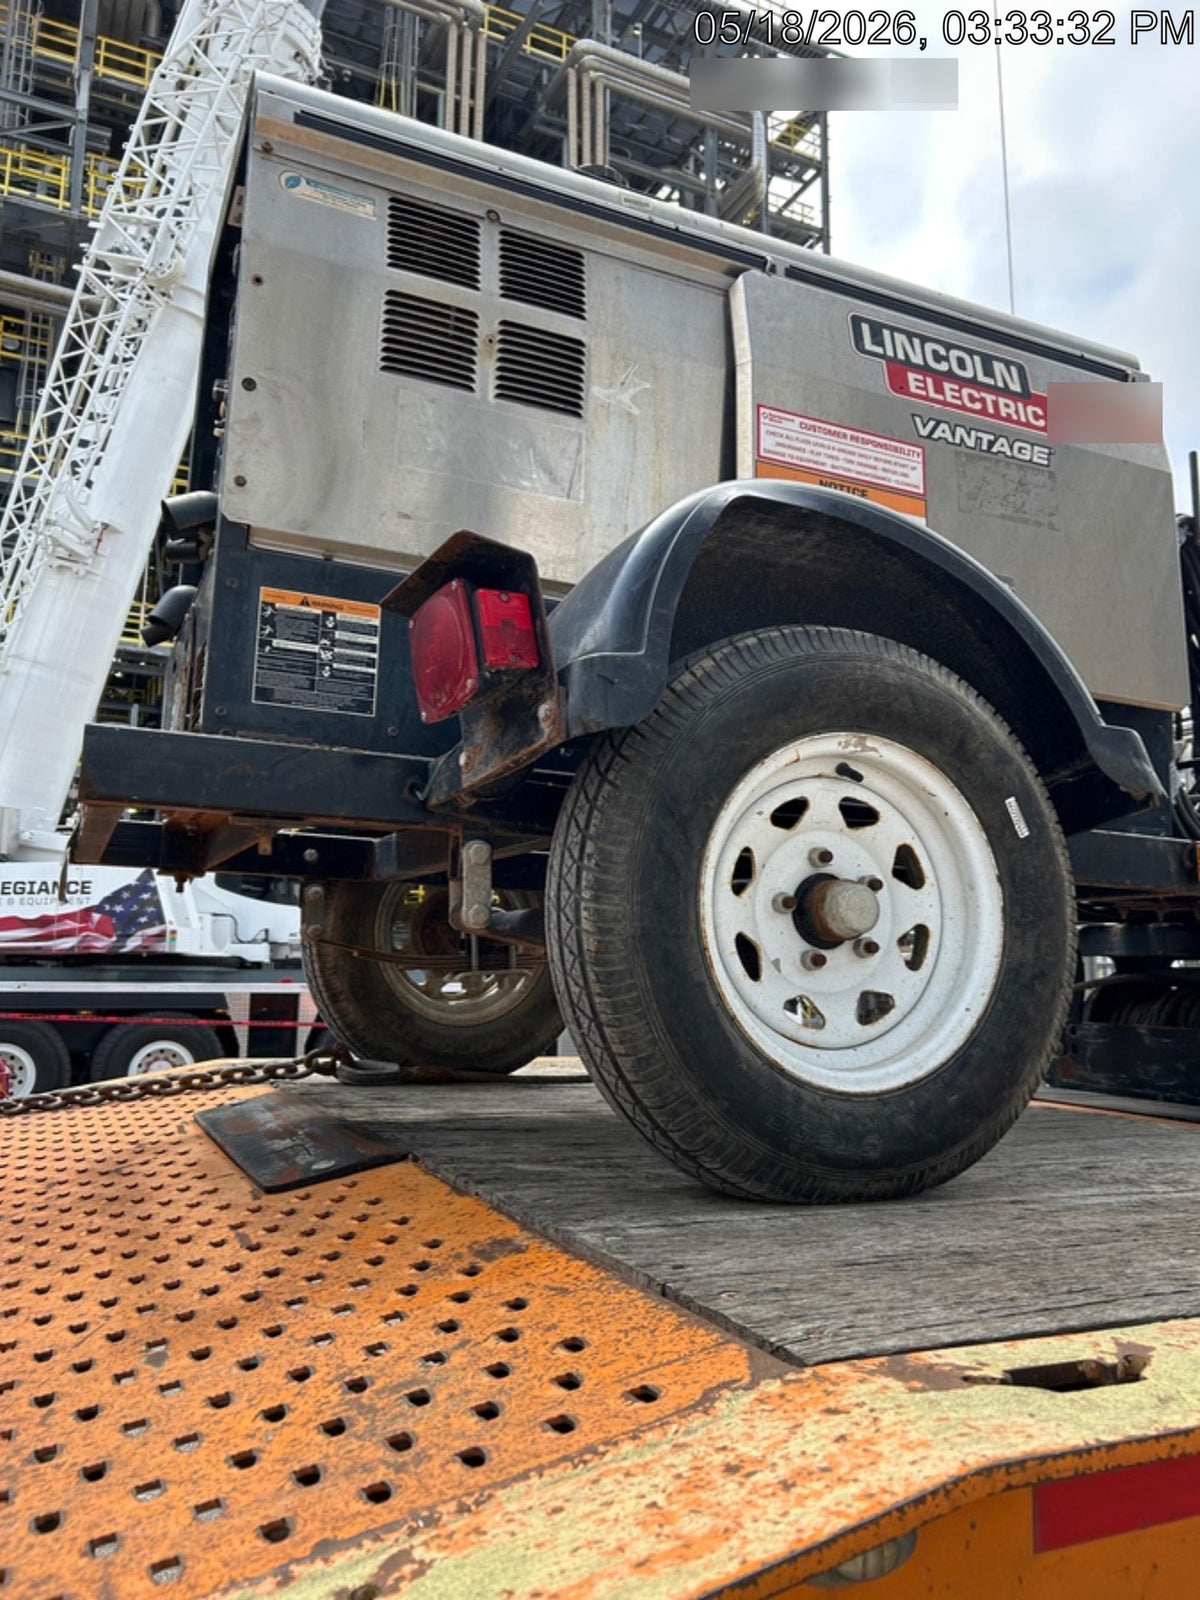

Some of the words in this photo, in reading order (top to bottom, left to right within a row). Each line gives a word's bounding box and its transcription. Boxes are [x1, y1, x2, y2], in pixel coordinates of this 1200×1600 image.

[860, 322, 1023, 393] LINCOLN
[906, 371, 1047, 428] ELECTRIC
[799, 420, 848, 440] CUSTOMER
[849, 432, 920, 459] RESPONSIBILITY
[912, 414, 1051, 467] VANTAGE
